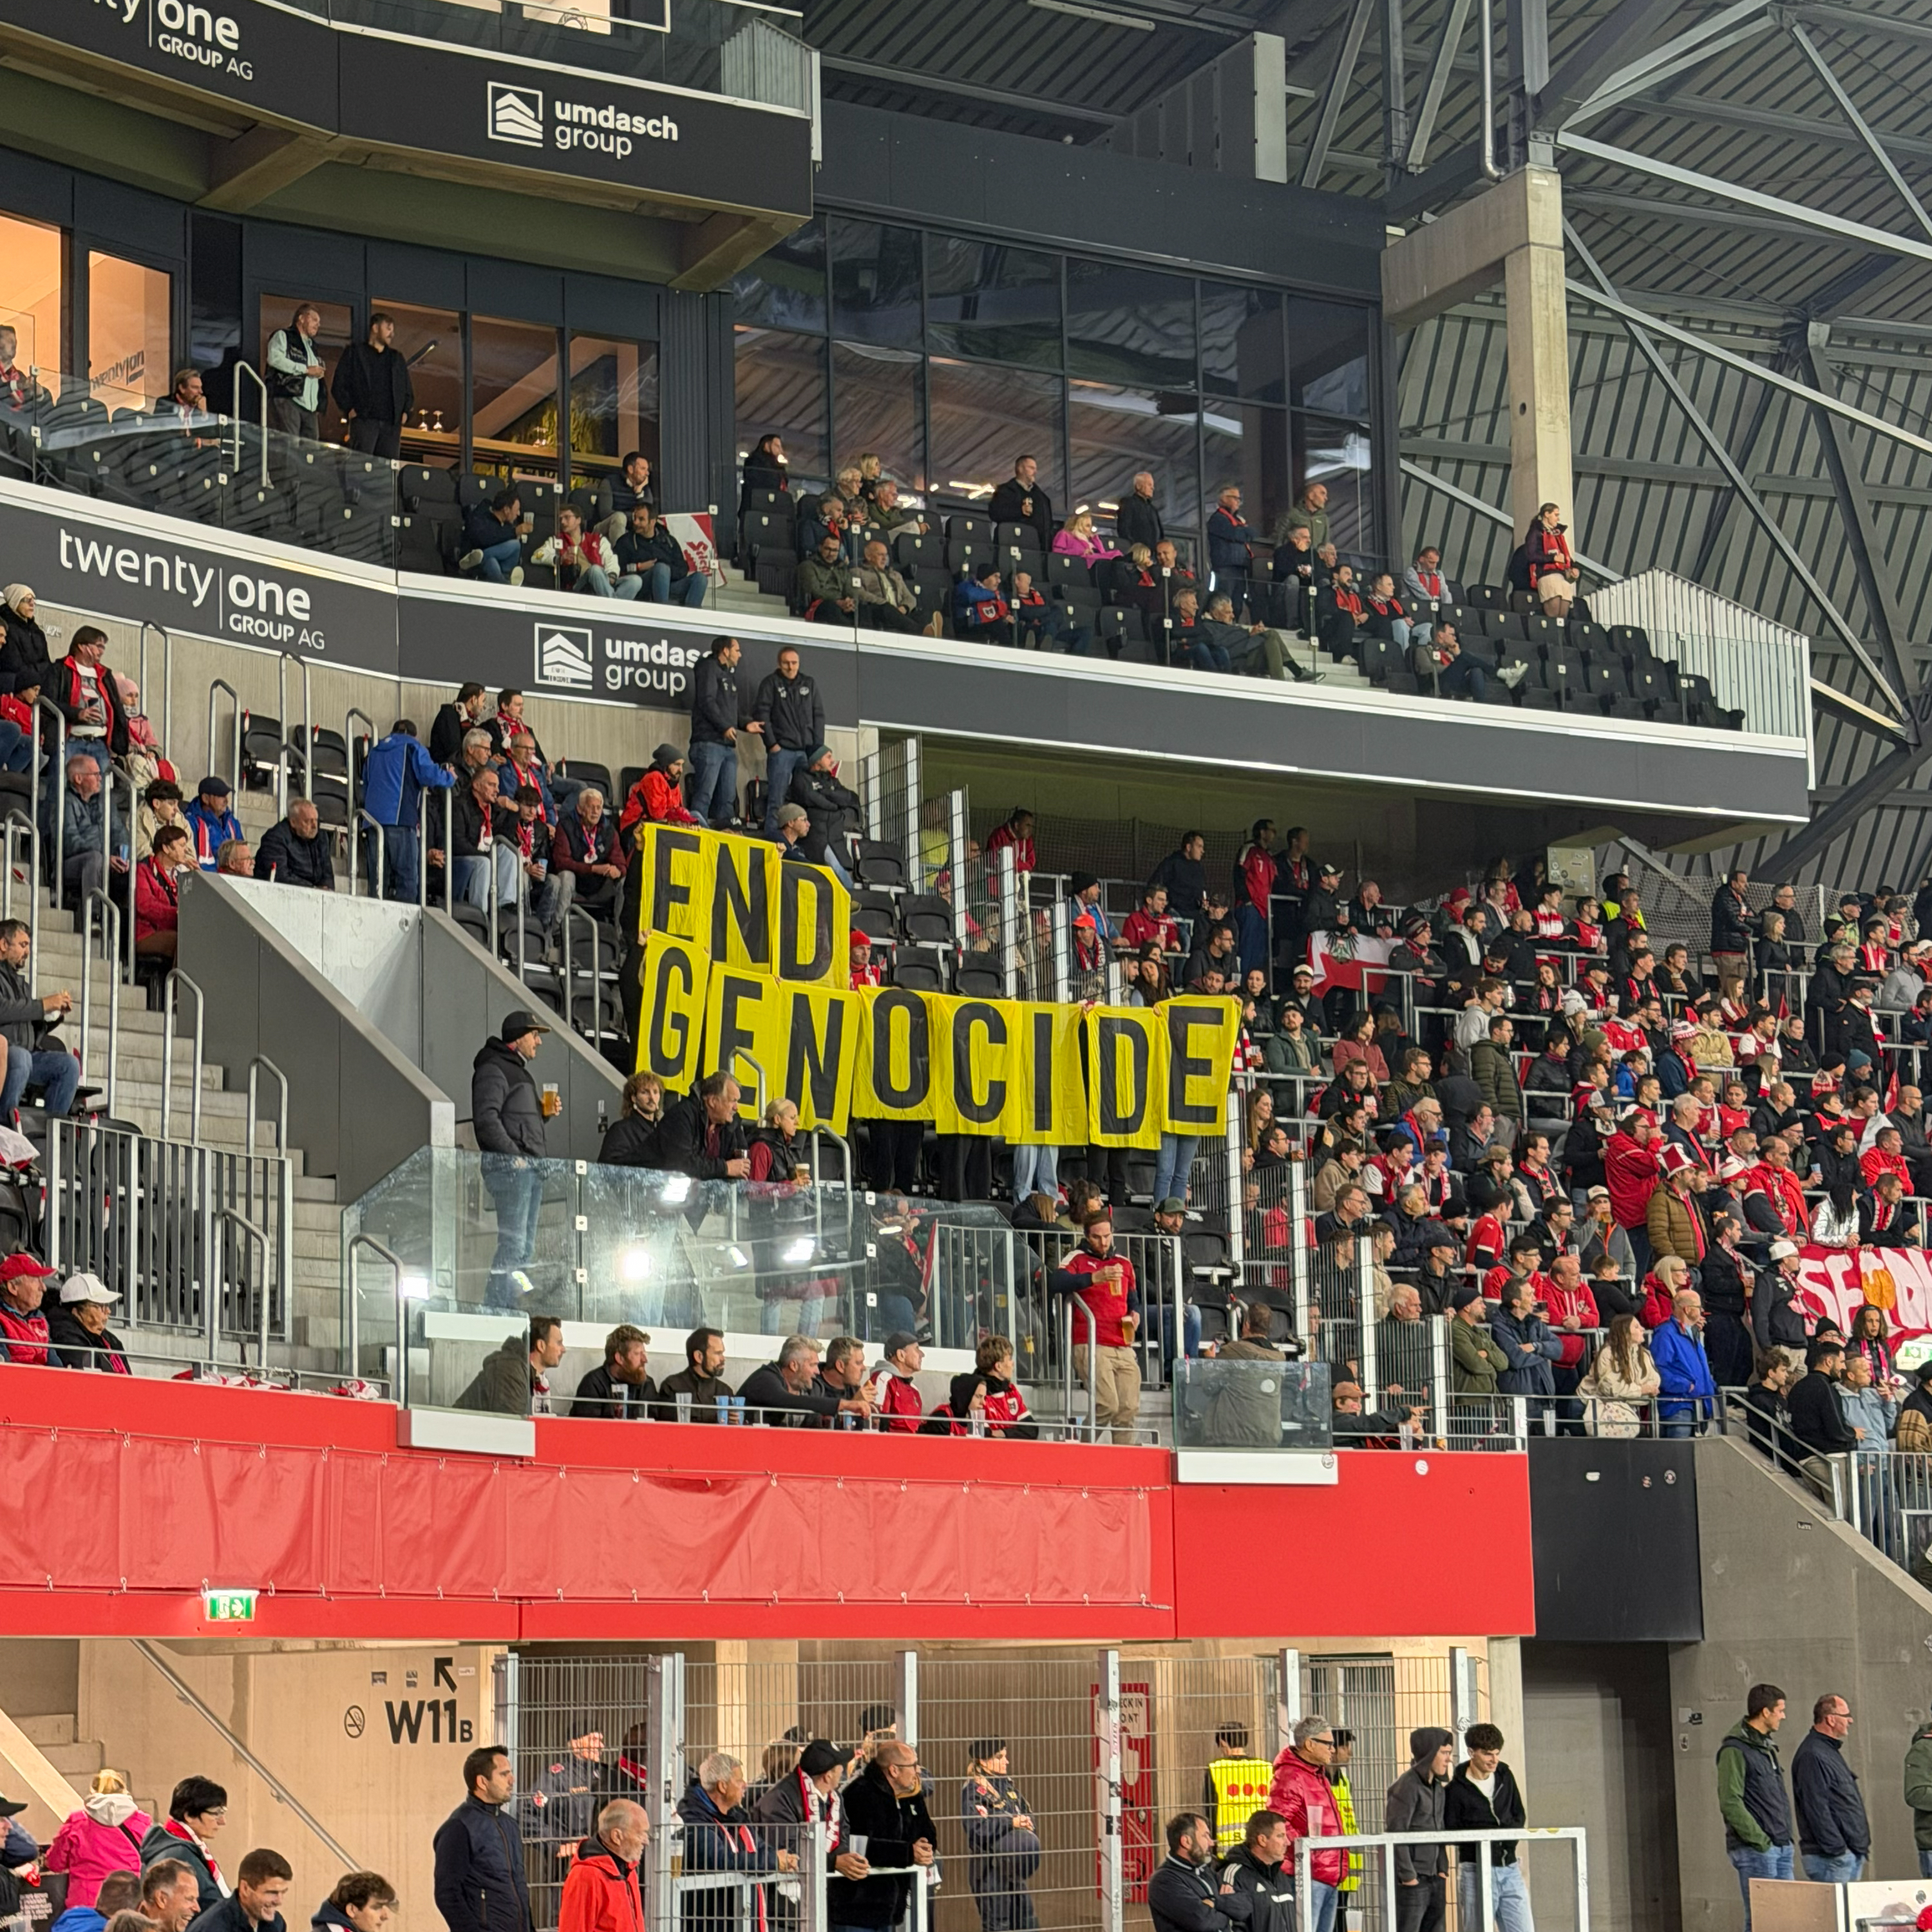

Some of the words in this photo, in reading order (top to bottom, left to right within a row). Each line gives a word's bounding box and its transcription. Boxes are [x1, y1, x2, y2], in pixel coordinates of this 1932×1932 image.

[158, 0, 240, 51] one
[158, 33, 223, 68] GROUP
[225, 57, 253, 80] AG
[554, 100, 679, 141] umdasch
[554, 125, 633, 160] group
[60, 528, 214, 608] twenty
[228, 573, 312, 621] one
[229, 612, 295, 643] GROUP
[298, 627, 325, 650] AG
[604, 638, 713, 668] umdas
[605, 663, 687, 697] group
[652, 828, 834, 982] END
[649, 947, 1224, 1135] GENOCIDE
